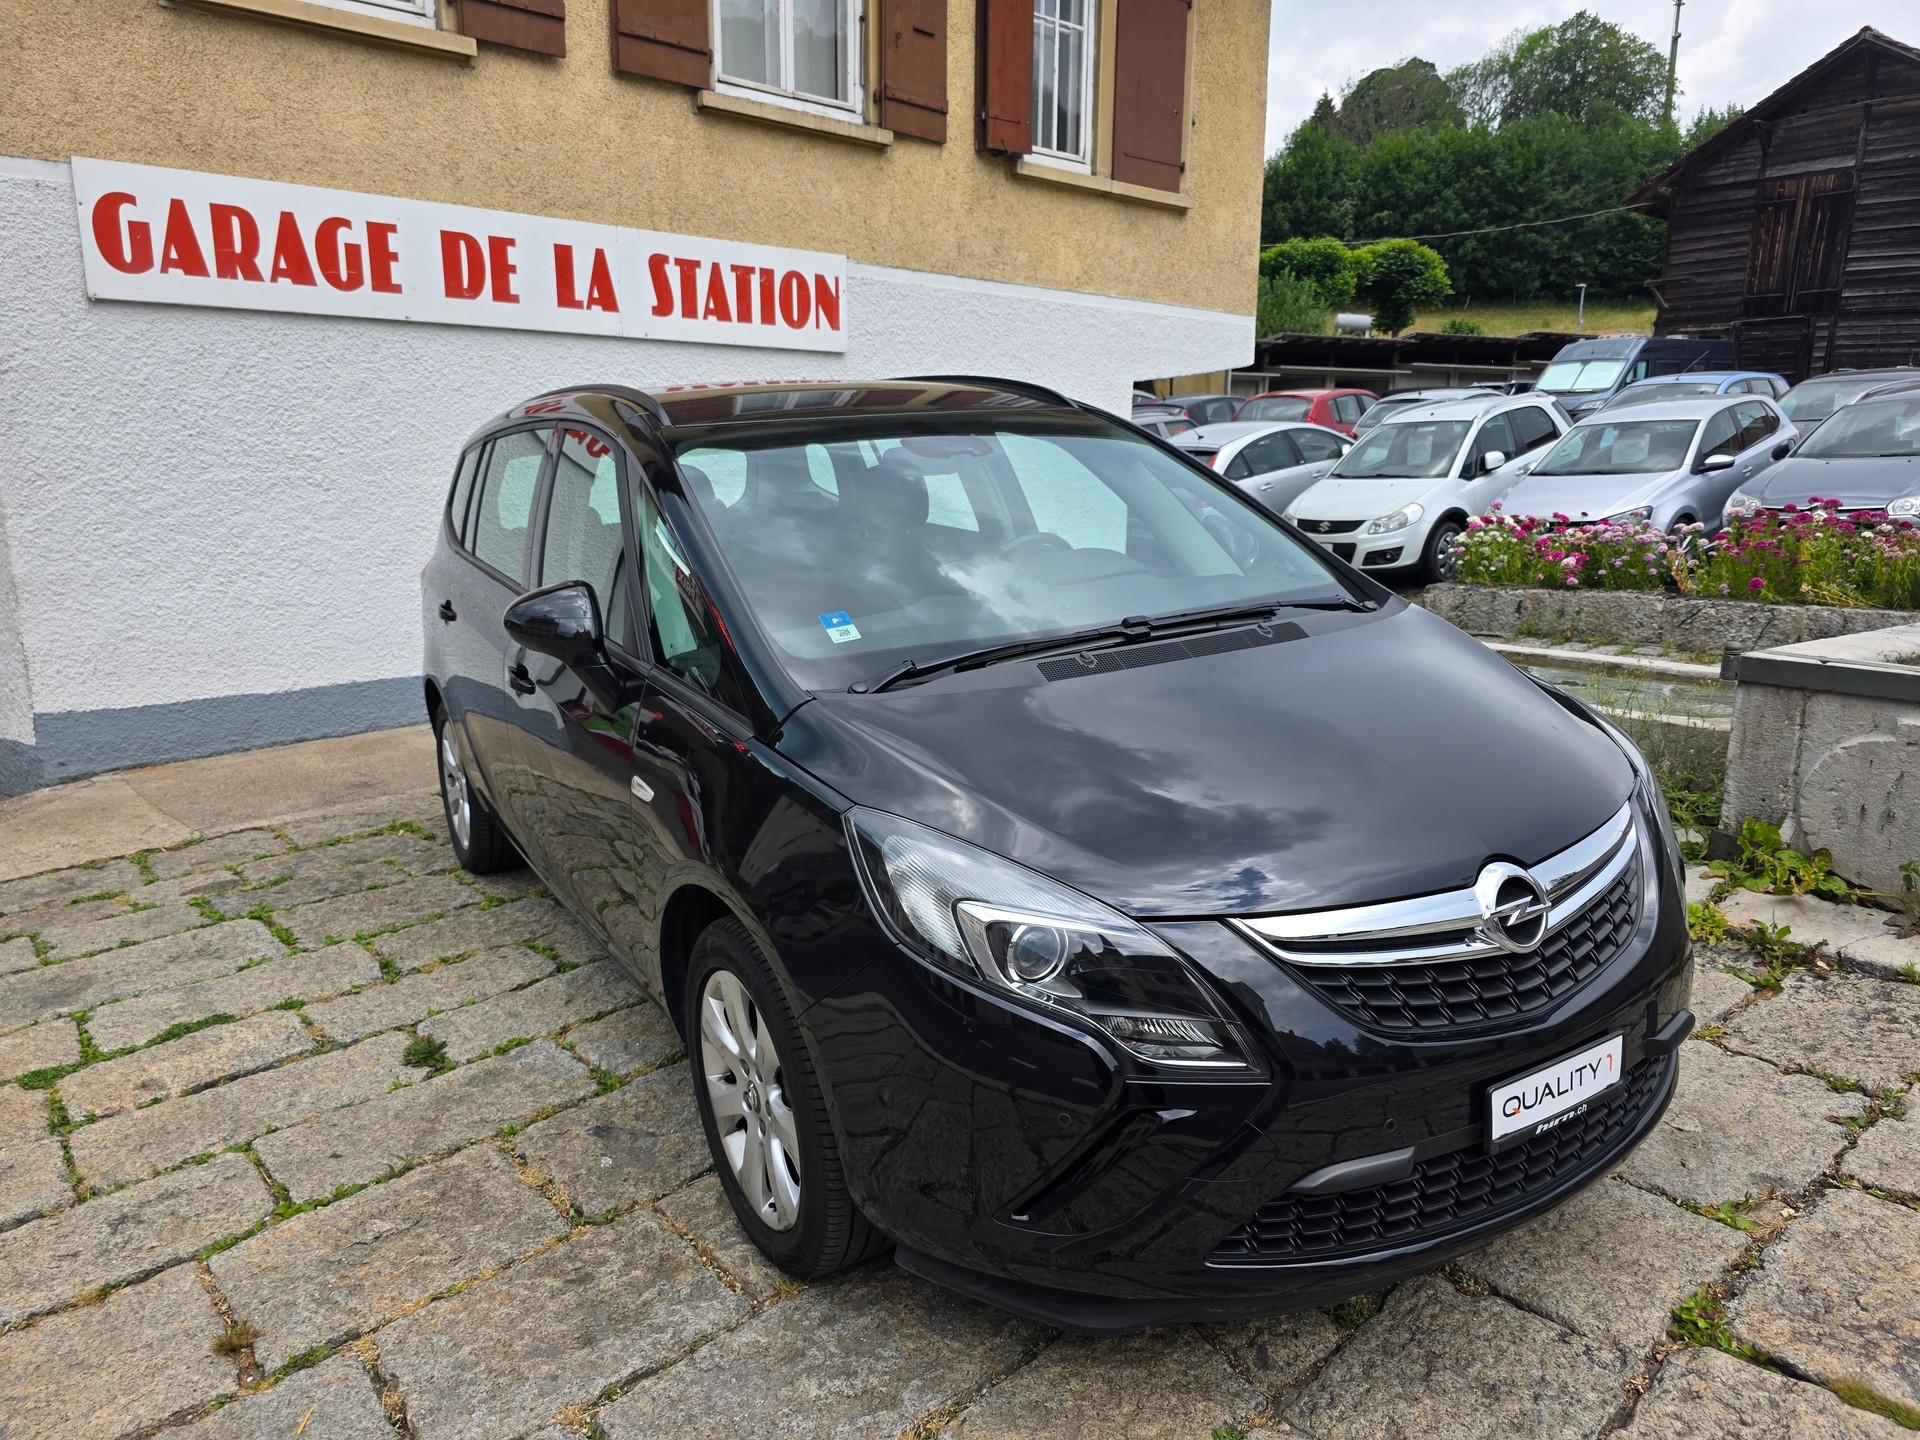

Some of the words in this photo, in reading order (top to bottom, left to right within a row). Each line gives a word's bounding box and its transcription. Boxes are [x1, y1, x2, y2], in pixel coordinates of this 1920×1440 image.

[92, 191, 402, 294] GARAGE
[440, 230, 520, 304] DE
[554, 243, 619, 313] LA
[648, 253, 840, 331] STATION
